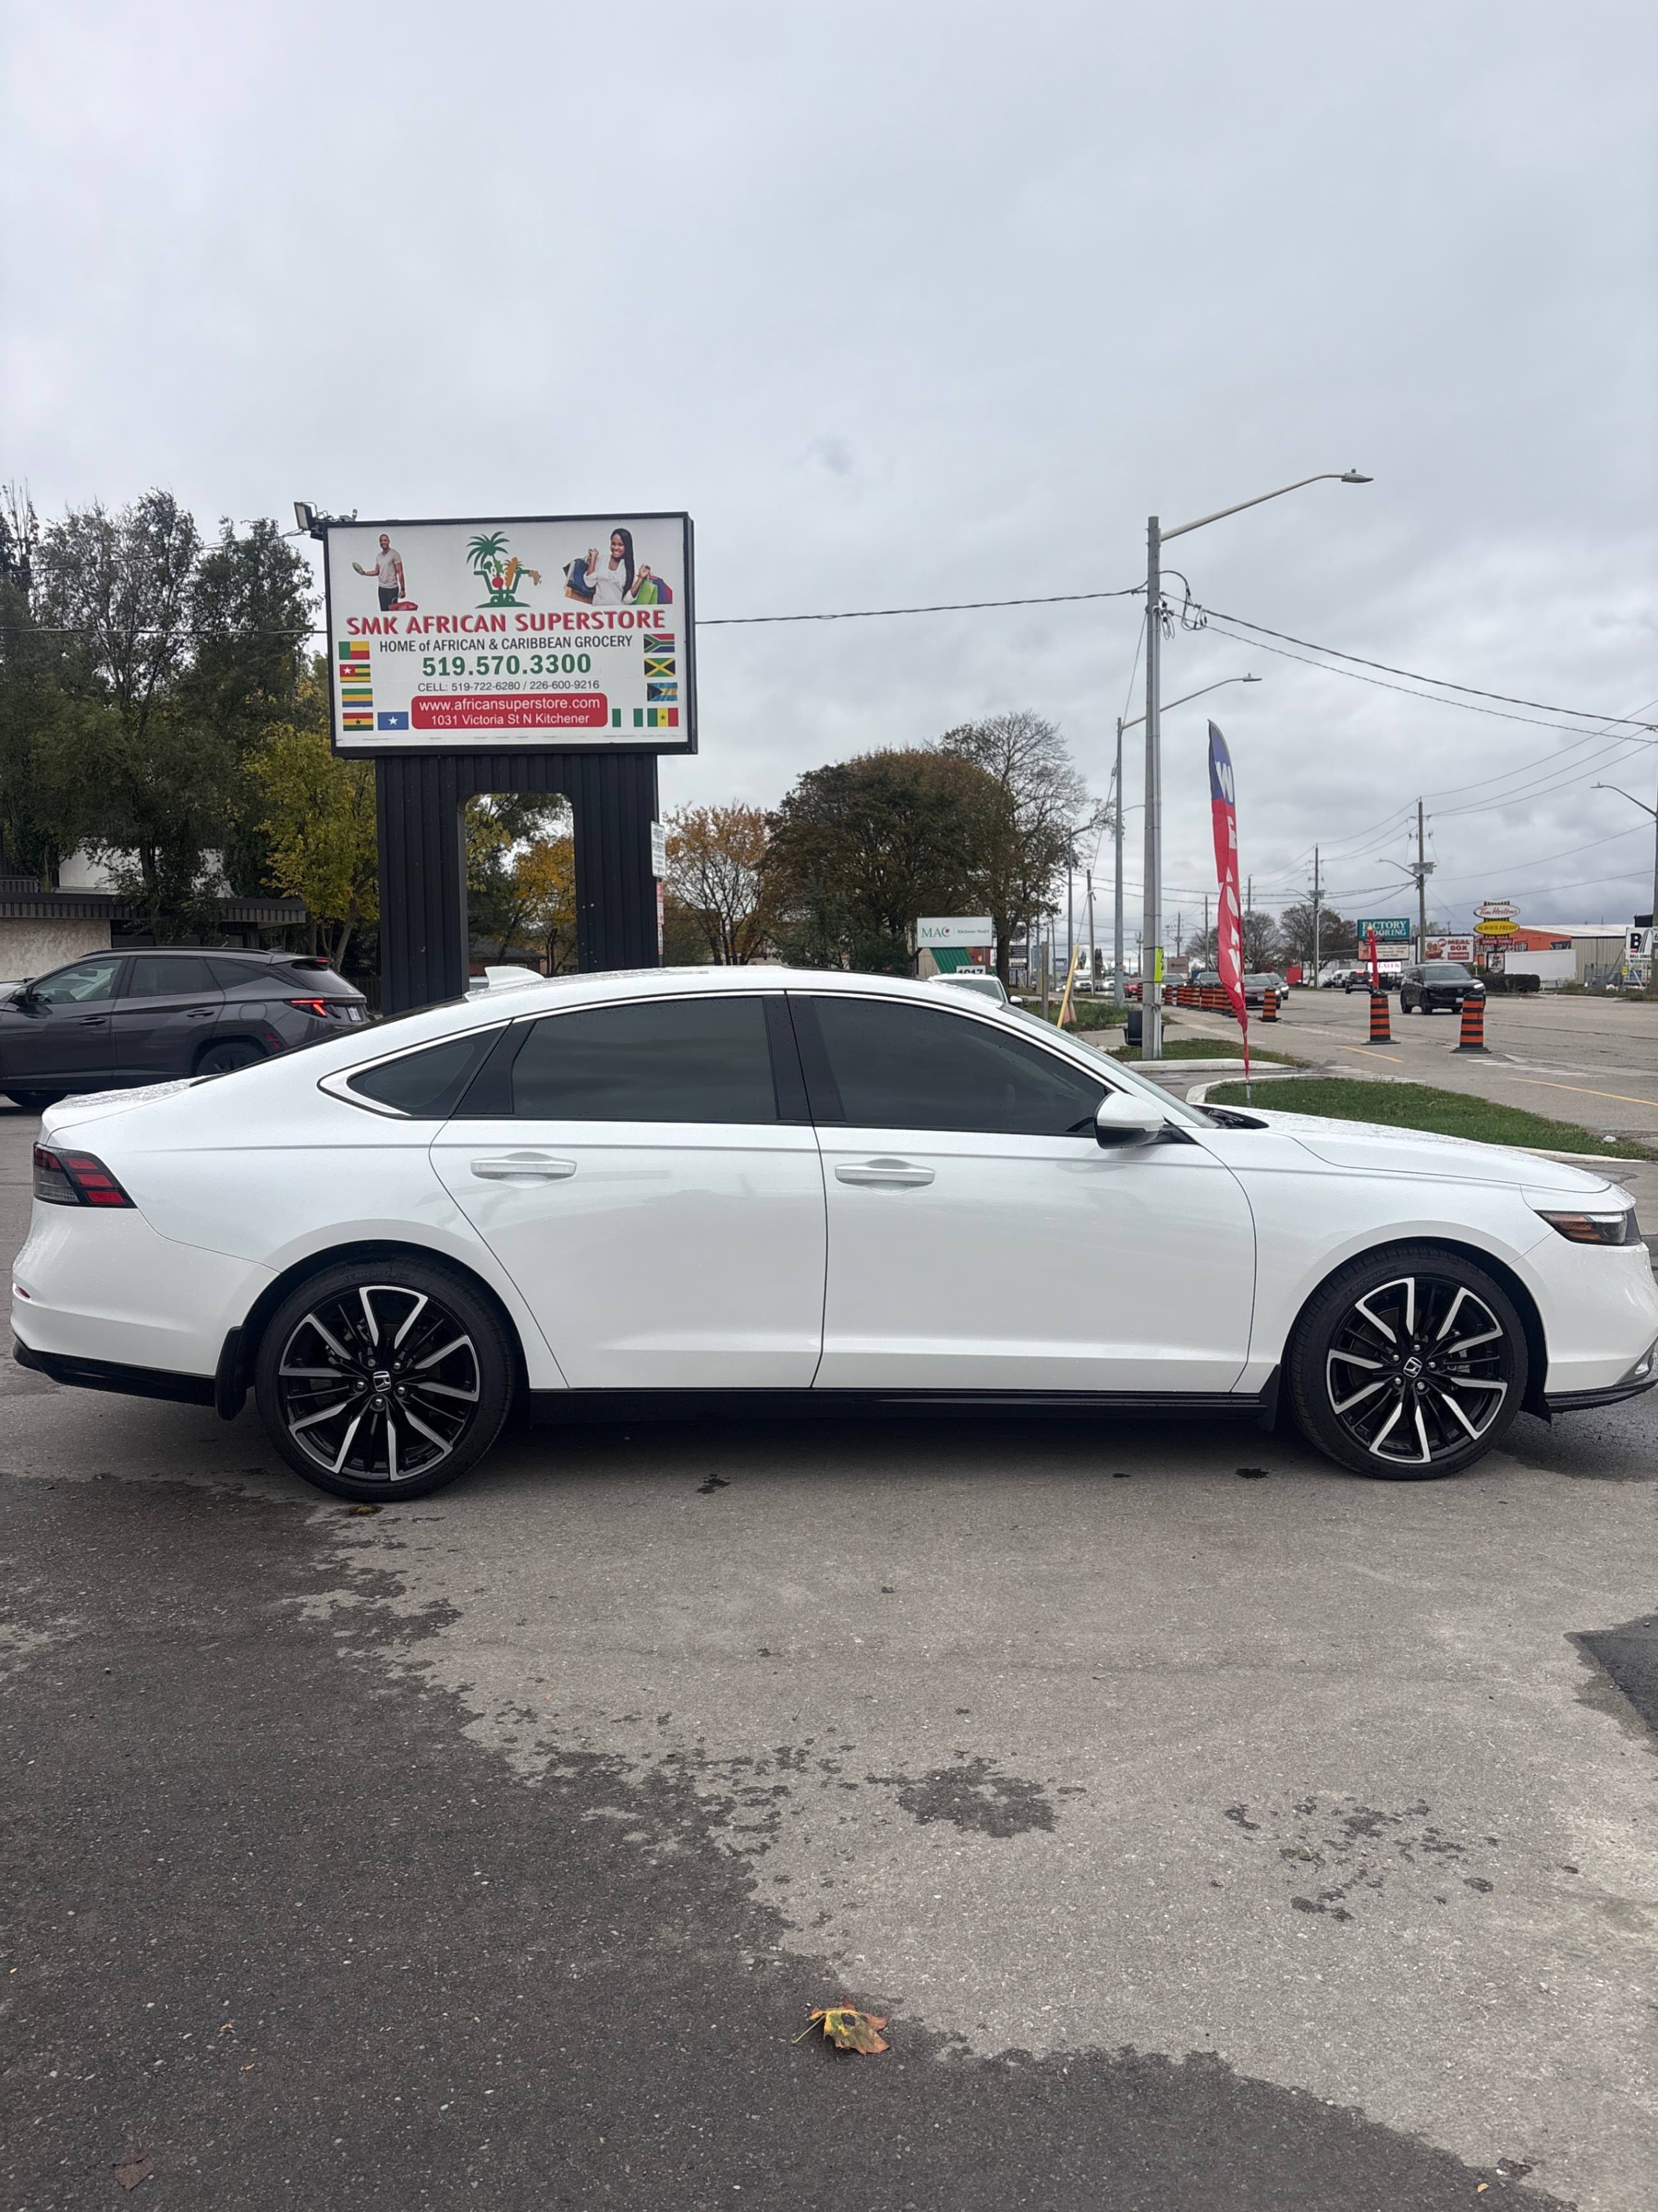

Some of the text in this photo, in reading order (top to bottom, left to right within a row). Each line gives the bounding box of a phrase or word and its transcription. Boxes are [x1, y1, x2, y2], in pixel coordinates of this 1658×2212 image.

[346, 609, 666, 635] SMK AFRICAN SUPERSTORE
[379, 635, 633, 652] HOME of AFRICAN & CARIBBEAN GROCERY
[422, 653, 591, 677] 519.570.3300
[417, 680, 600, 692] CELL: 519-722-6280 / 226-600-9216
[419, 697, 600, 713] www.africansuperstore.com
[431, 713, 590, 725] 1031 Victoria St N Kitchener
[1480, 906, 1517, 915] Tim Hortons
[921, 926, 950, 938] MAC
